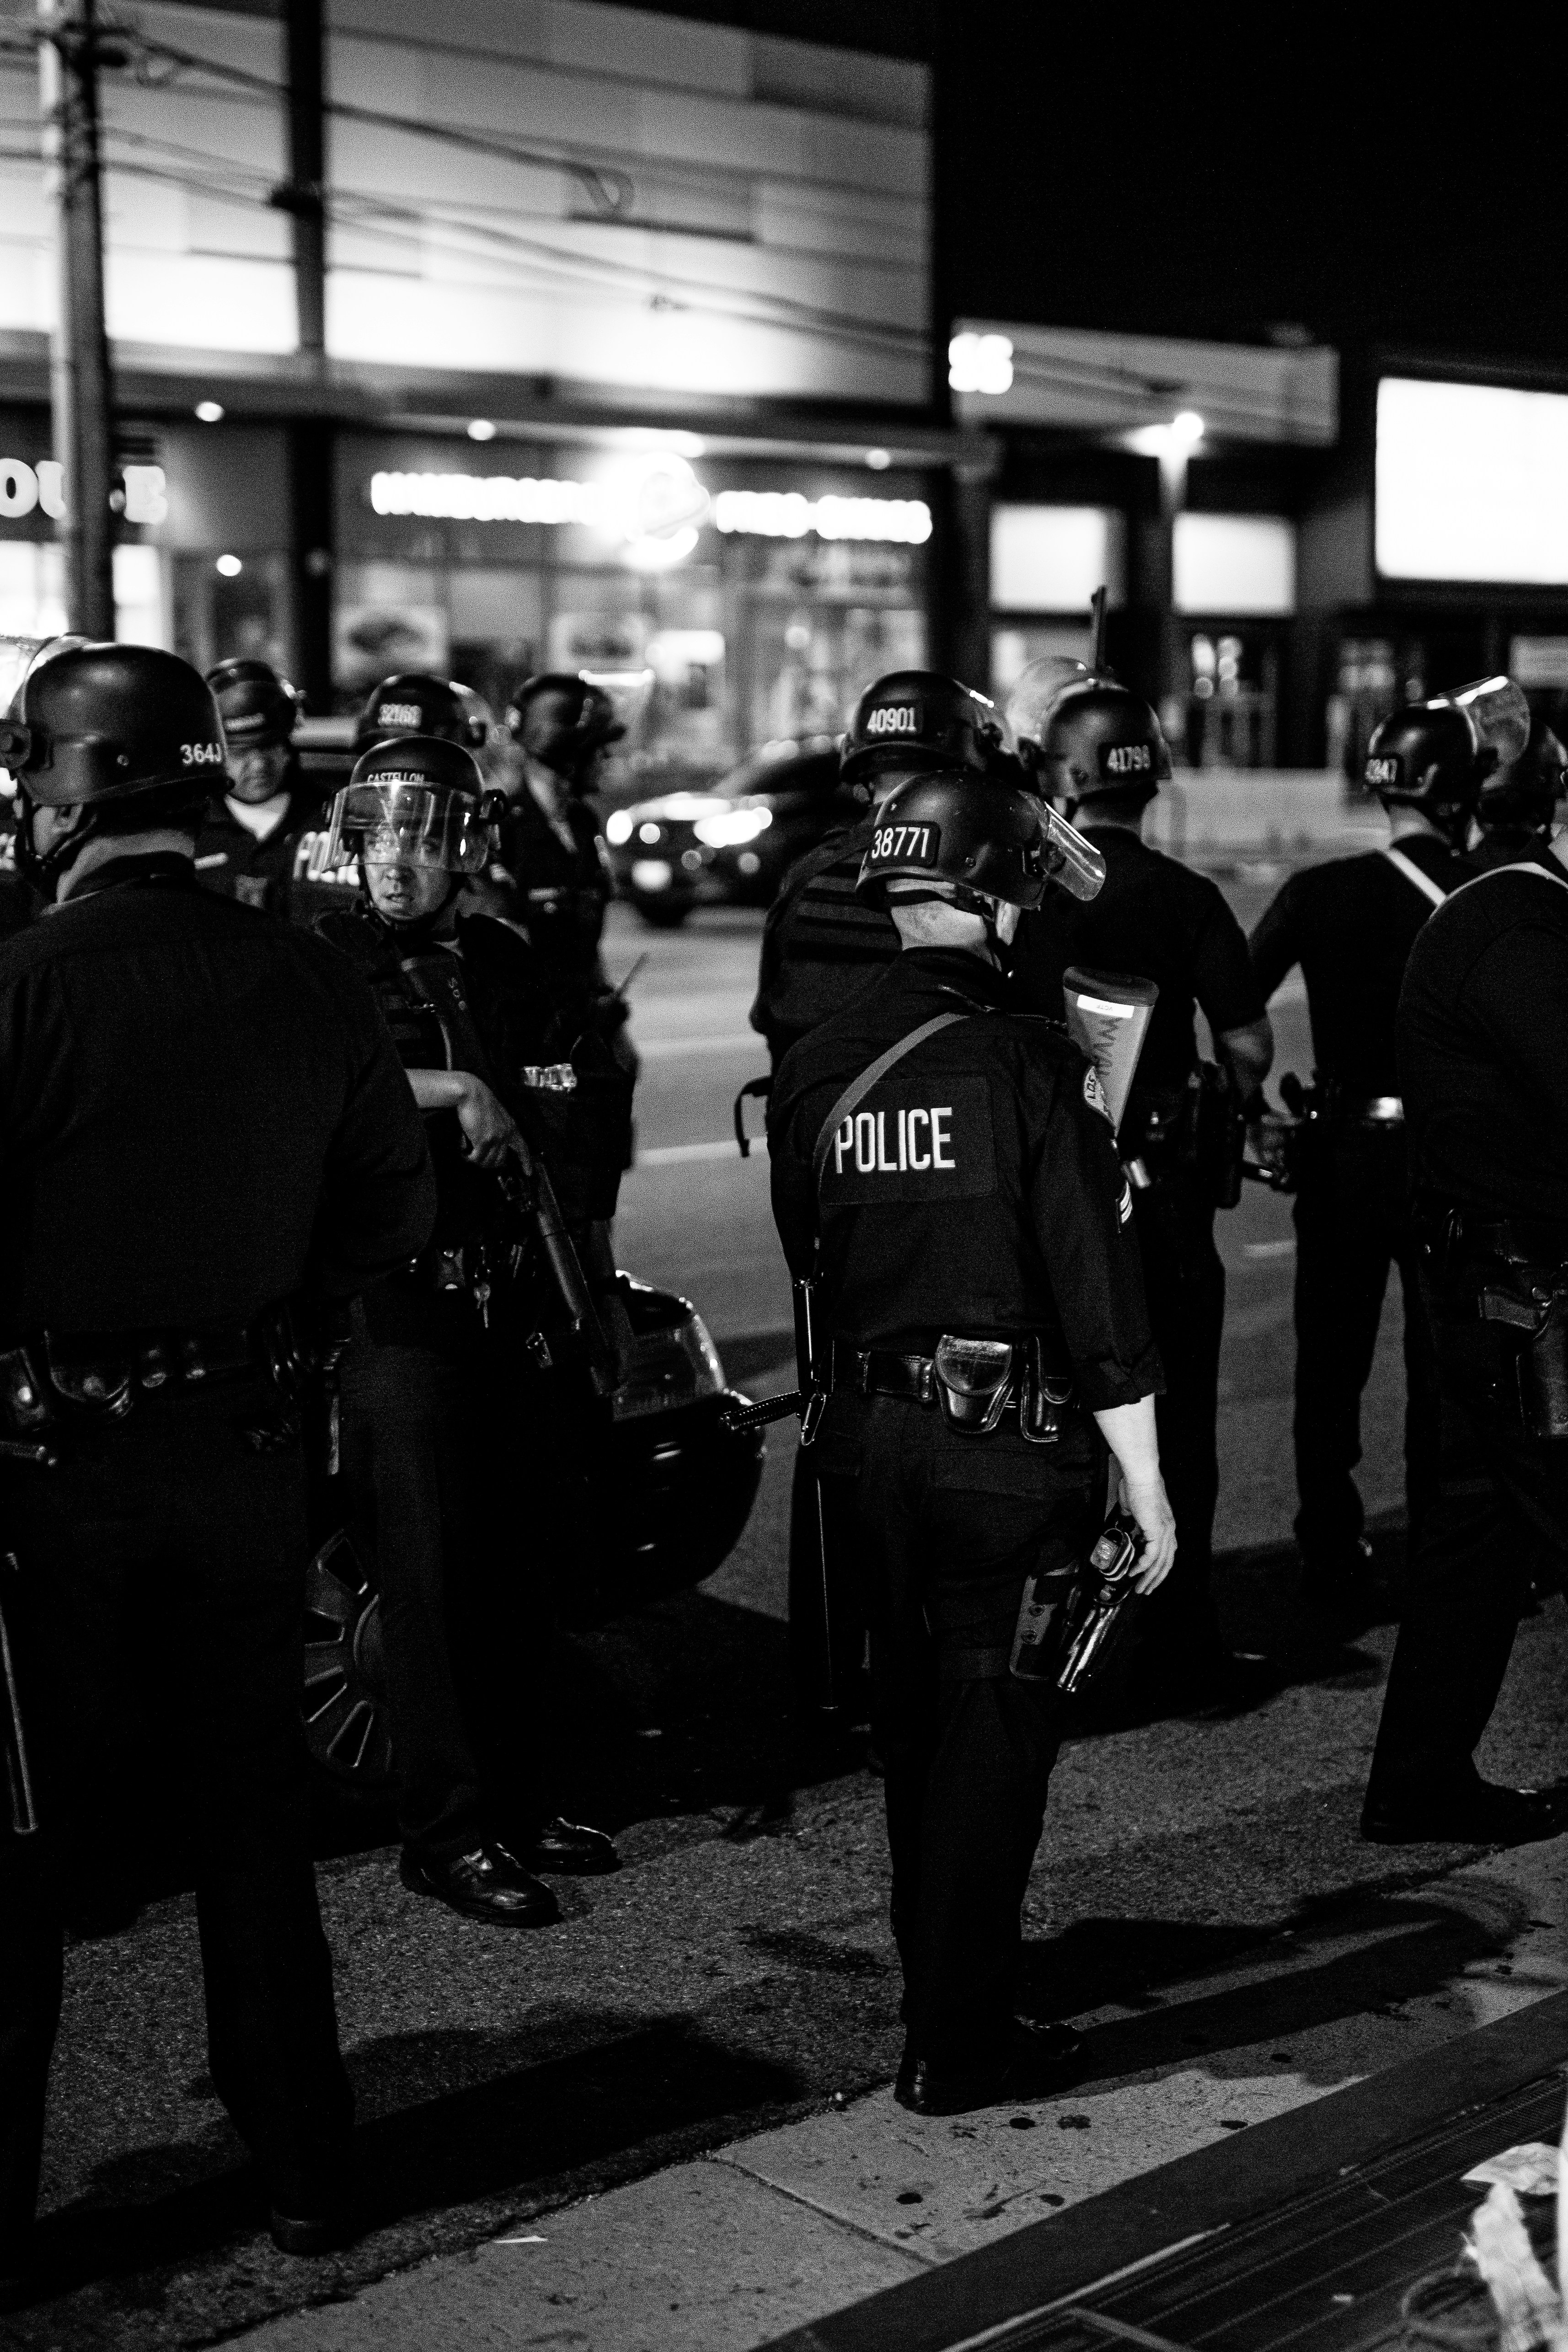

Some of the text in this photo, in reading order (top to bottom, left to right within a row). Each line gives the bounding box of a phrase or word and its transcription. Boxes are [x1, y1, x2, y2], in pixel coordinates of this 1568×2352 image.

[867, 707, 916, 732] 40901
[872, 827, 929, 858] 38771
[835, 1107, 956, 1173] POLICE
